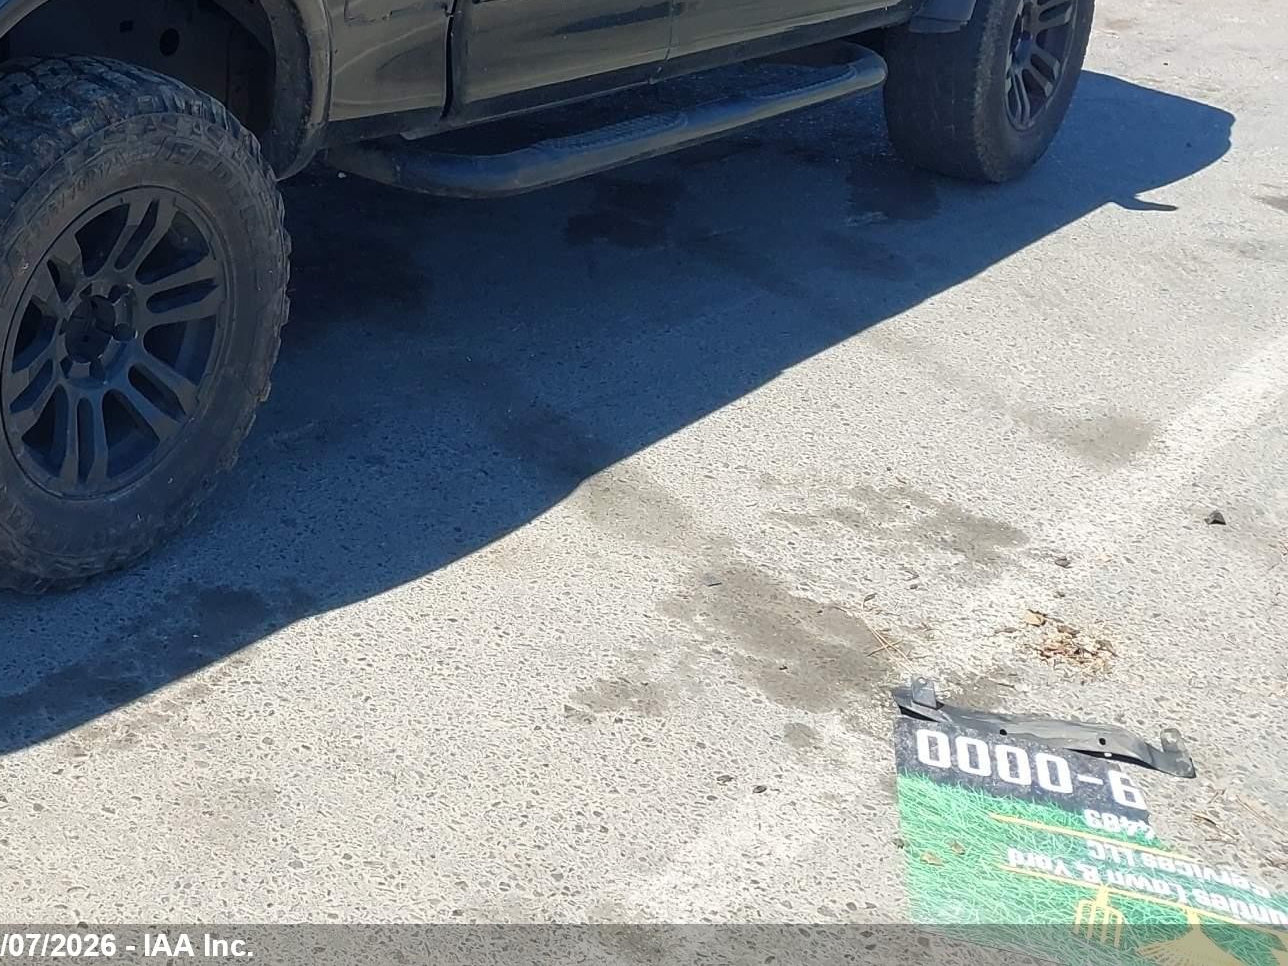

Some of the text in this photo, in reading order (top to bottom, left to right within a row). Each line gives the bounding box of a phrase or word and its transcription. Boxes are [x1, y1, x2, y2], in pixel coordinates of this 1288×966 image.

[1007, 846, 1070, 879] Yard
[1087, 839, 1135, 867] LLC
[1075, 860, 1100, 883] &
